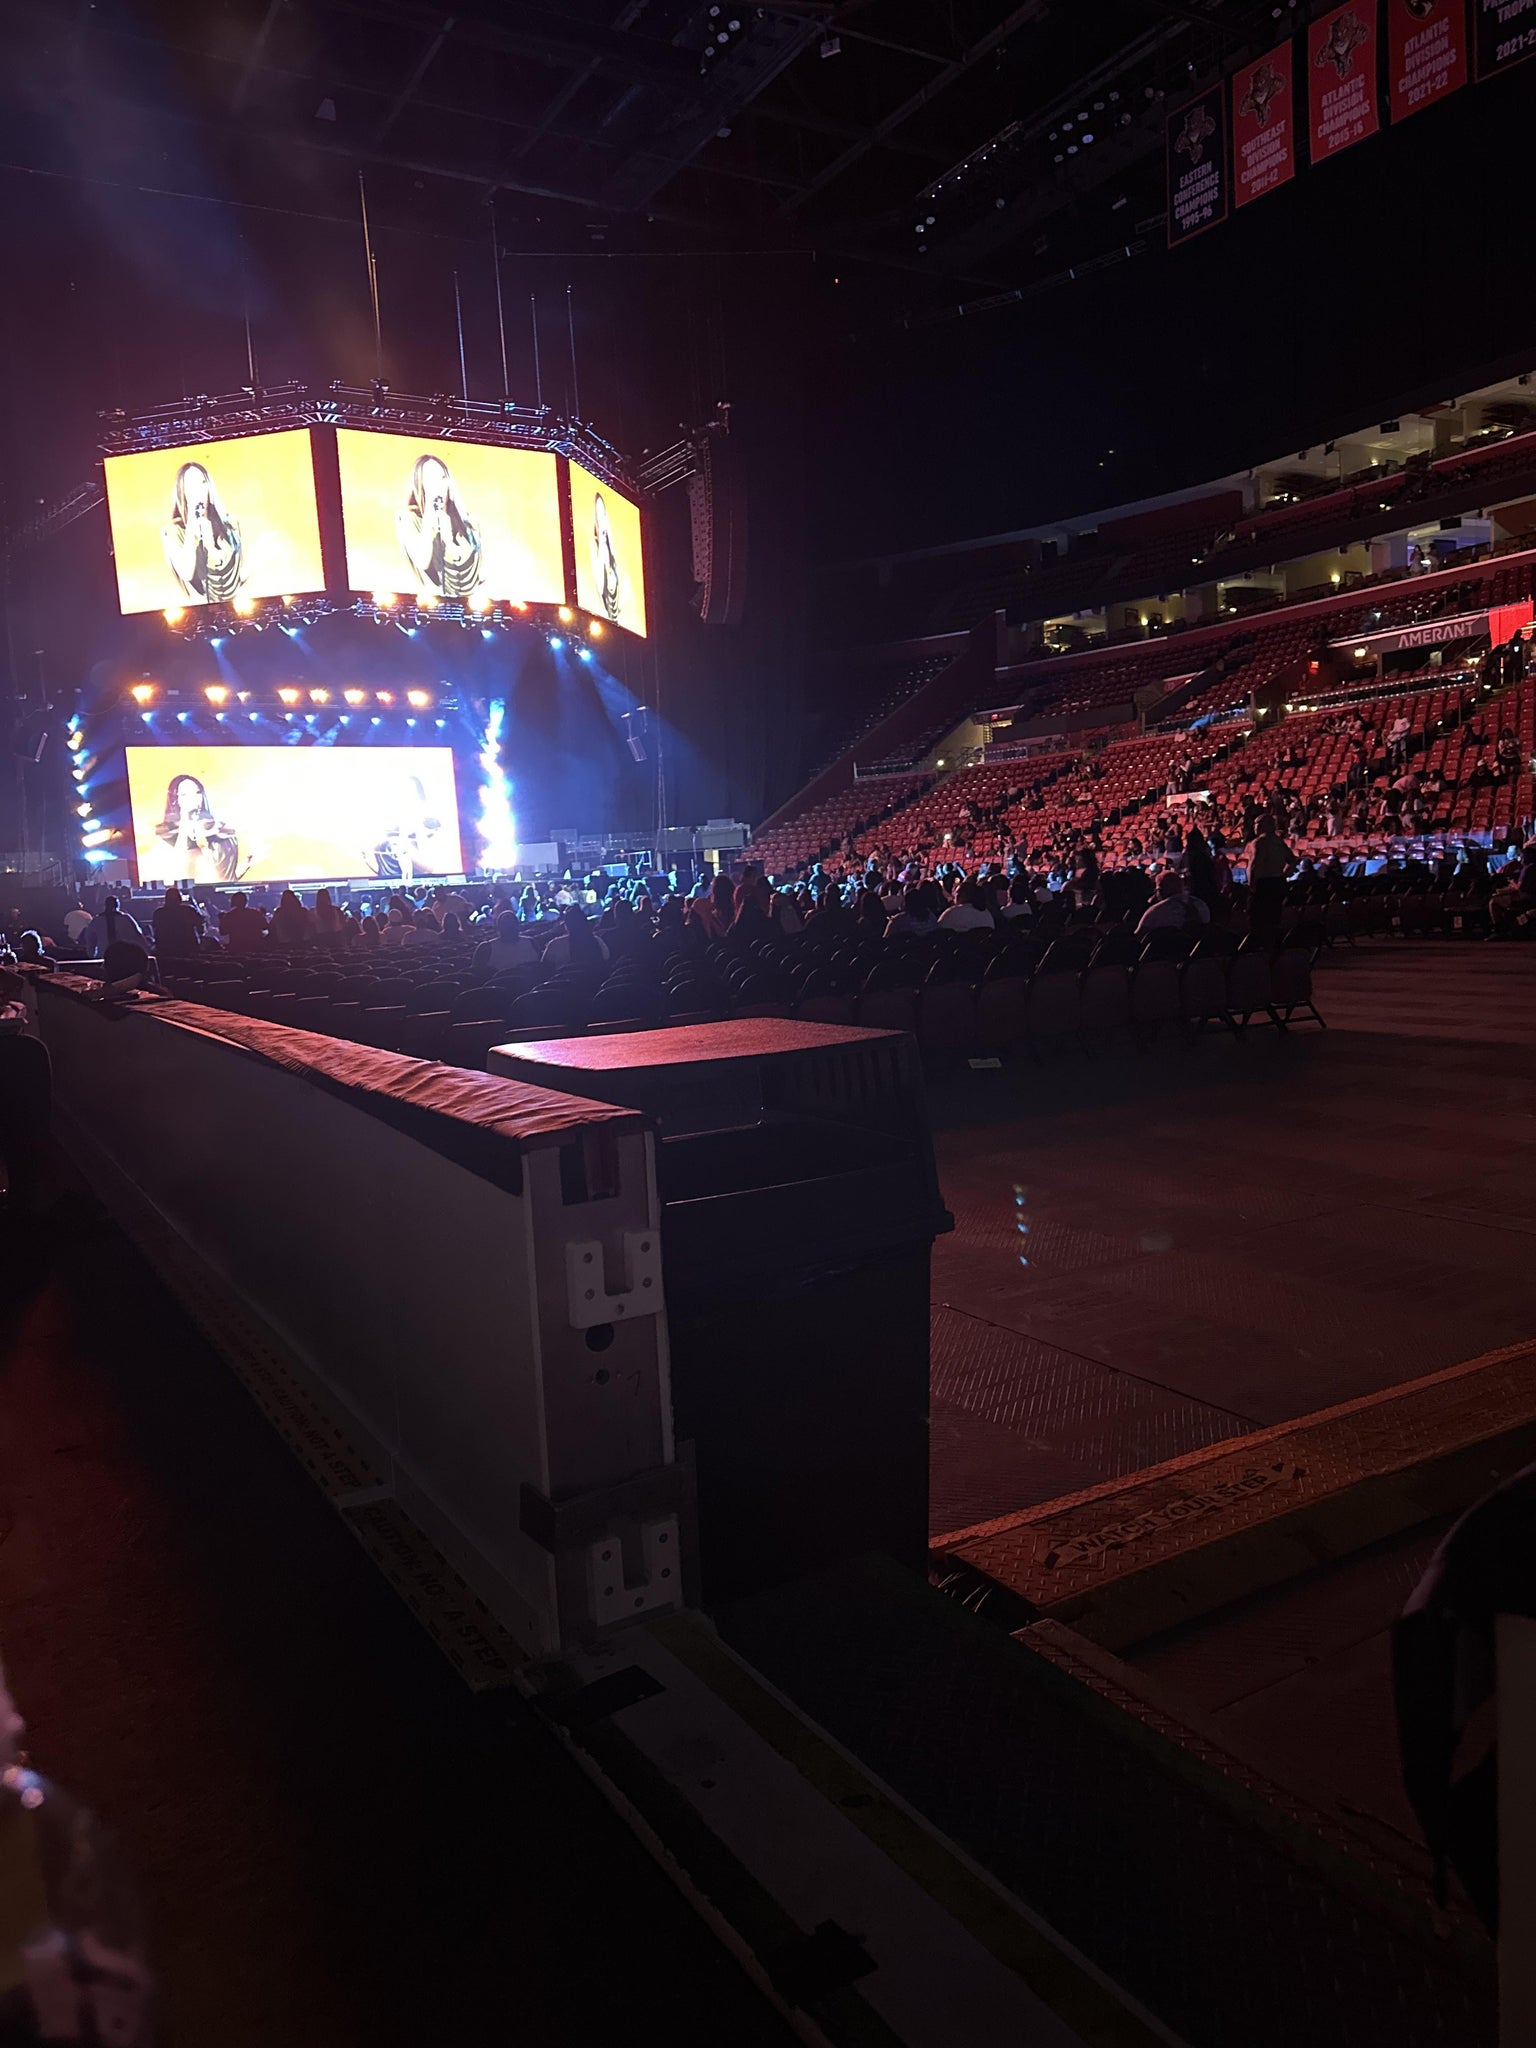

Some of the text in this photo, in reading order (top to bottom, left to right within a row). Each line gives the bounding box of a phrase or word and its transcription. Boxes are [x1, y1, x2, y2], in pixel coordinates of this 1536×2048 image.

[1497, 0, 1536, 23] TROPH
[1404, 17, 1450, 57] ATLANTIC
[1496, 22, 1536, 61] 2021-2
[1398, 48, 1457, 93] CHAMPIONS
[1405, 36, 1449, 73] DIVISION
[1321, 73, 1365, 108] ATLANTIC
[1323, 89, 1364, 121] DIVISION
[1407, 70, 1449, 106] 2021-22
[1317, 99, 1370, 138] CHAMPIONS
[1328, 120, 1364, 149] 2015-16
[1241, 119, 1286, 157] SOUTHEAST
[1247, 137, 1281, 168] DIVISION
[1179, 160, 1212, 189] EASTERN
[1240, 147, 1288, 184] CHAMPIONS
[1250, 167, 1279, 194] 2011-12
[1174, 171, 1220, 206] CONFERENCE
[1175, 187, 1219, 220] CHAMPIONS
[1181, 205, 1213, 231] 1995-96
[1398, 621, 1475, 649] AMERANT
[302, 1428, 331, 1452] NOT
[320, 1448, 338, 1461] A
[328, 1458, 362, 1490] STEP
[1073, 1475, 1269, 1552] WATCH YOUR STEP
[442, 1608, 466, 1625] A
[457, 1622, 508, 1673] STEP
